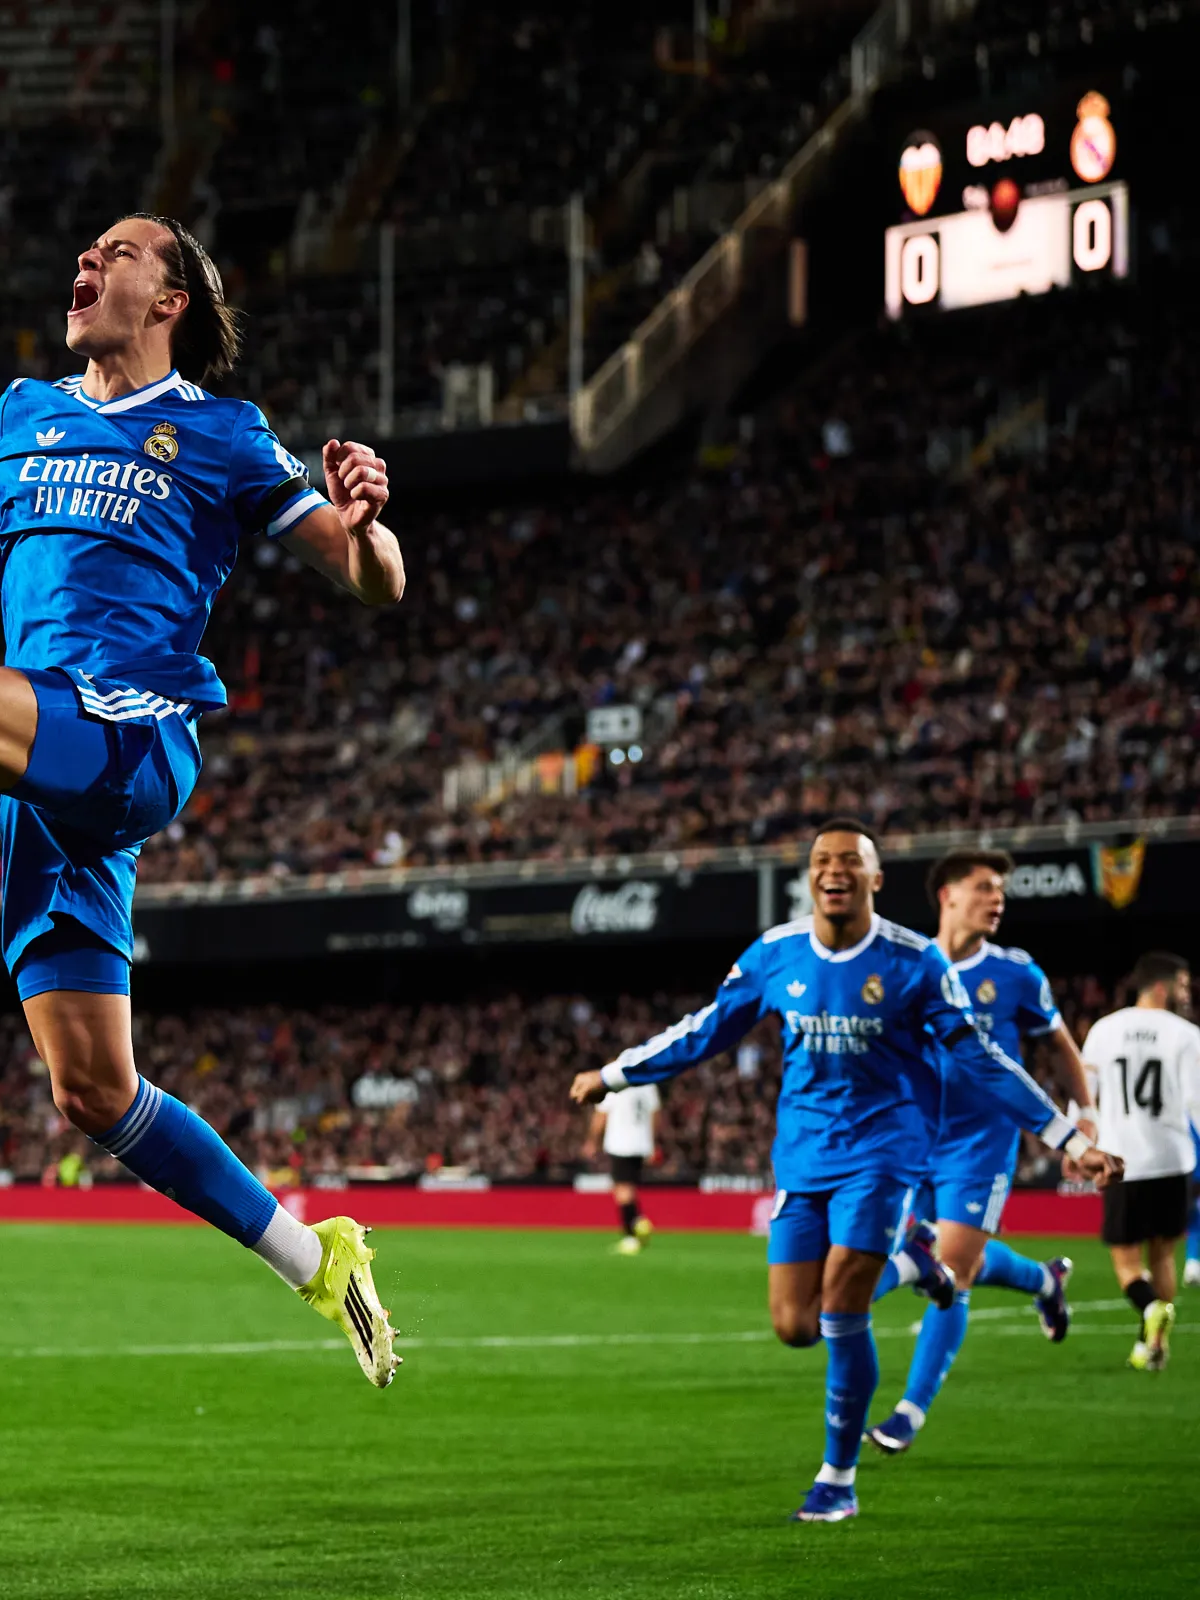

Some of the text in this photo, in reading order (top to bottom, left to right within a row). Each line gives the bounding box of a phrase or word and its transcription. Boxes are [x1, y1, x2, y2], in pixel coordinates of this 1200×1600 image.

[1073, 200, 1111, 272] 0
[901, 234, 940, 305] 0
[19, 453, 173, 500] Emirates
[34, 486, 141, 525] FLY BETTER
[1004, 862, 1086, 898] ODA
[785, 1010, 883, 1036] Emirates
[1115, 1056, 1163, 1118] 14
